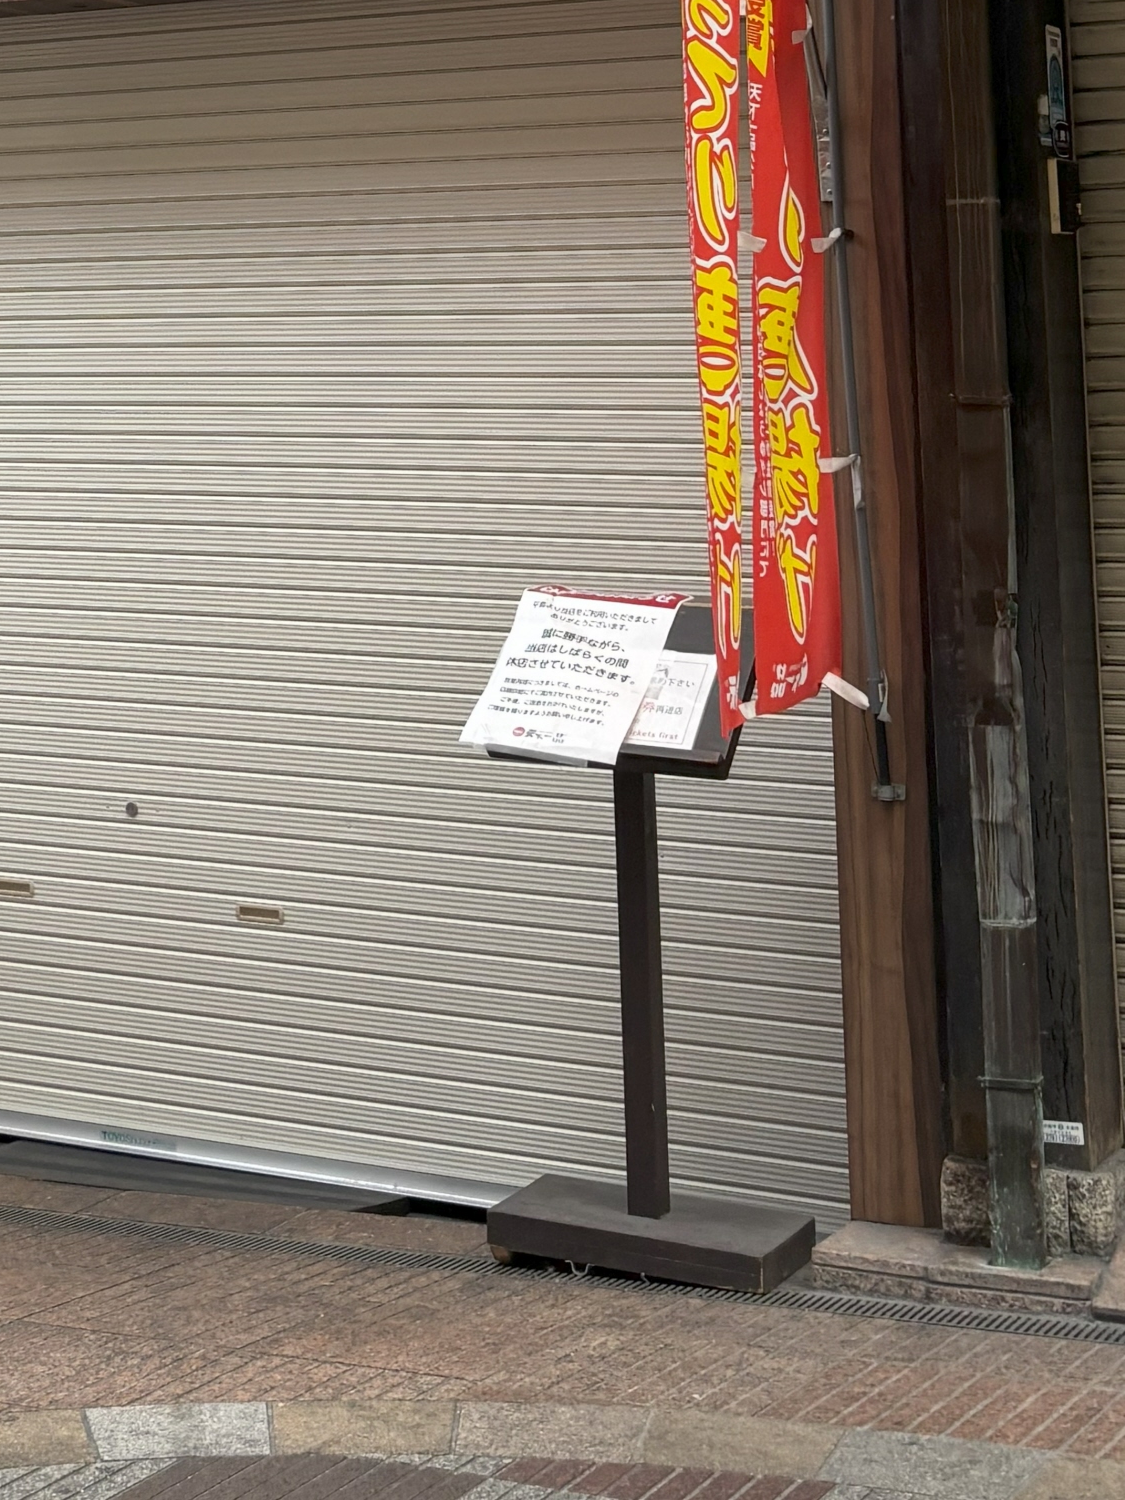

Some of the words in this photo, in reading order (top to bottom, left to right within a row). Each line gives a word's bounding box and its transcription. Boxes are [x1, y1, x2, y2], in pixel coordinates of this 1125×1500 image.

[524, 643, 630, 669] 当店はしばらくの間
